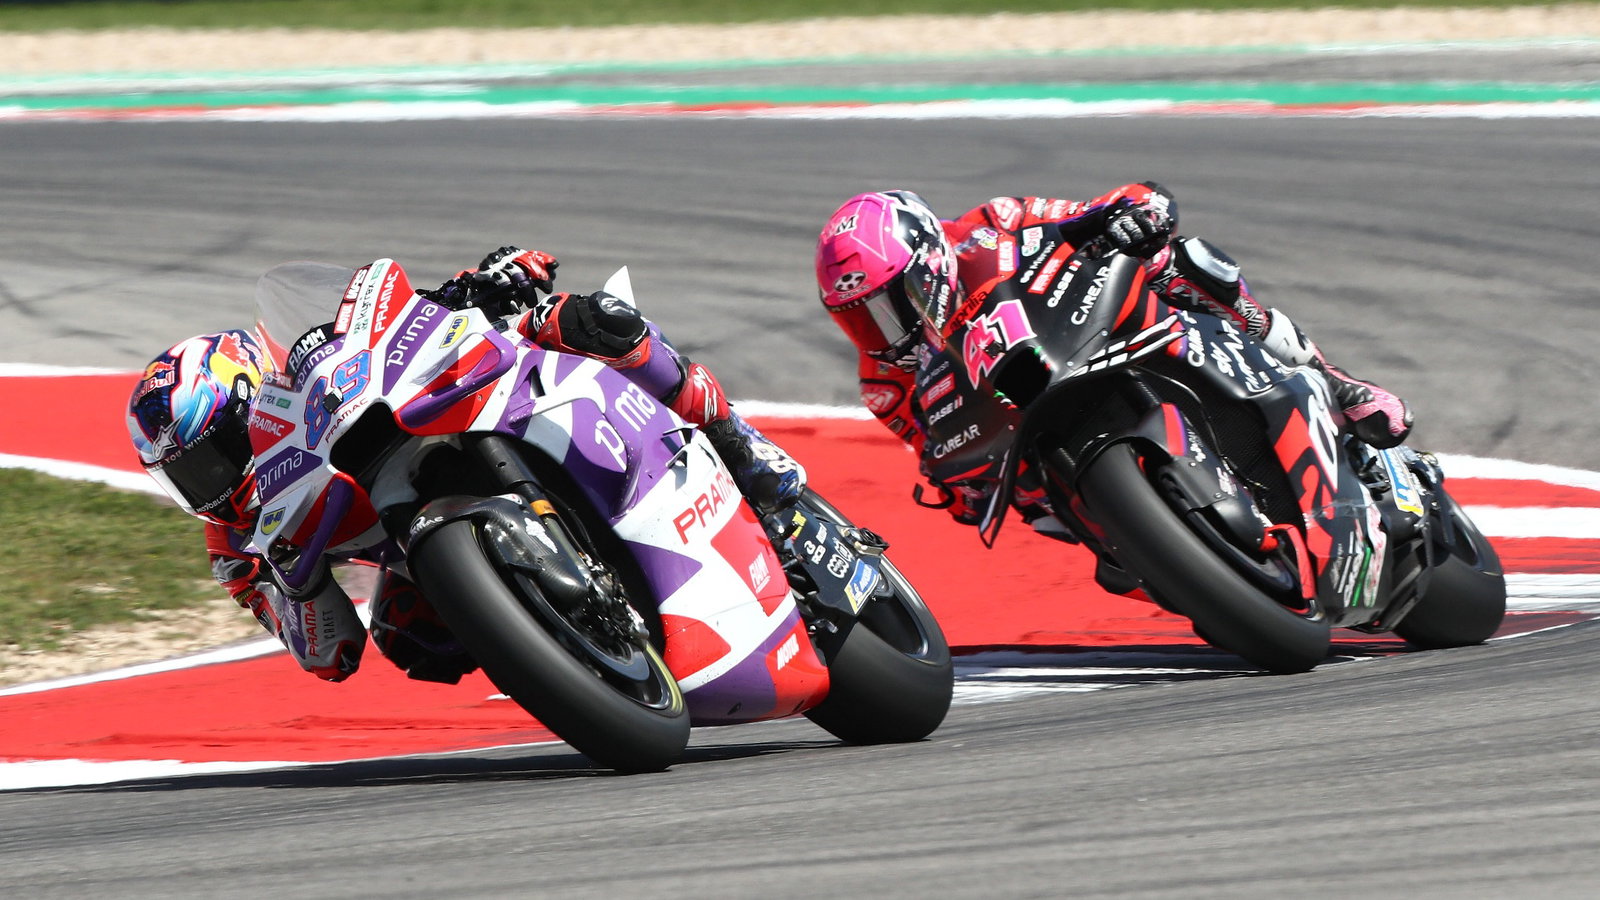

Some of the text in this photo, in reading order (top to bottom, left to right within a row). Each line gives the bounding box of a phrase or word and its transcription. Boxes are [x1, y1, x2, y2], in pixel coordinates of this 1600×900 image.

[374, 270, 400, 333] PRAMAC
[949, 291, 988, 331] aprilia
[1071, 265, 1112, 325] CAREAR
[289, 328, 327, 372] FIAMM
[386, 304, 438, 366] prima
[963, 299, 1037, 390] 41
[297, 344, 336, 387] prima
[305, 349, 373, 450] 89
[325, 397, 369, 443] PRAMAC
[166, 451, 182, 465] YOU
[185, 425, 216, 450] WINGS
[251, 415, 285, 437] PRAMAC
[934, 424, 981, 459] CAREAR
[257, 451, 303, 499] prima
[304, 600, 321, 658] PRAMA
